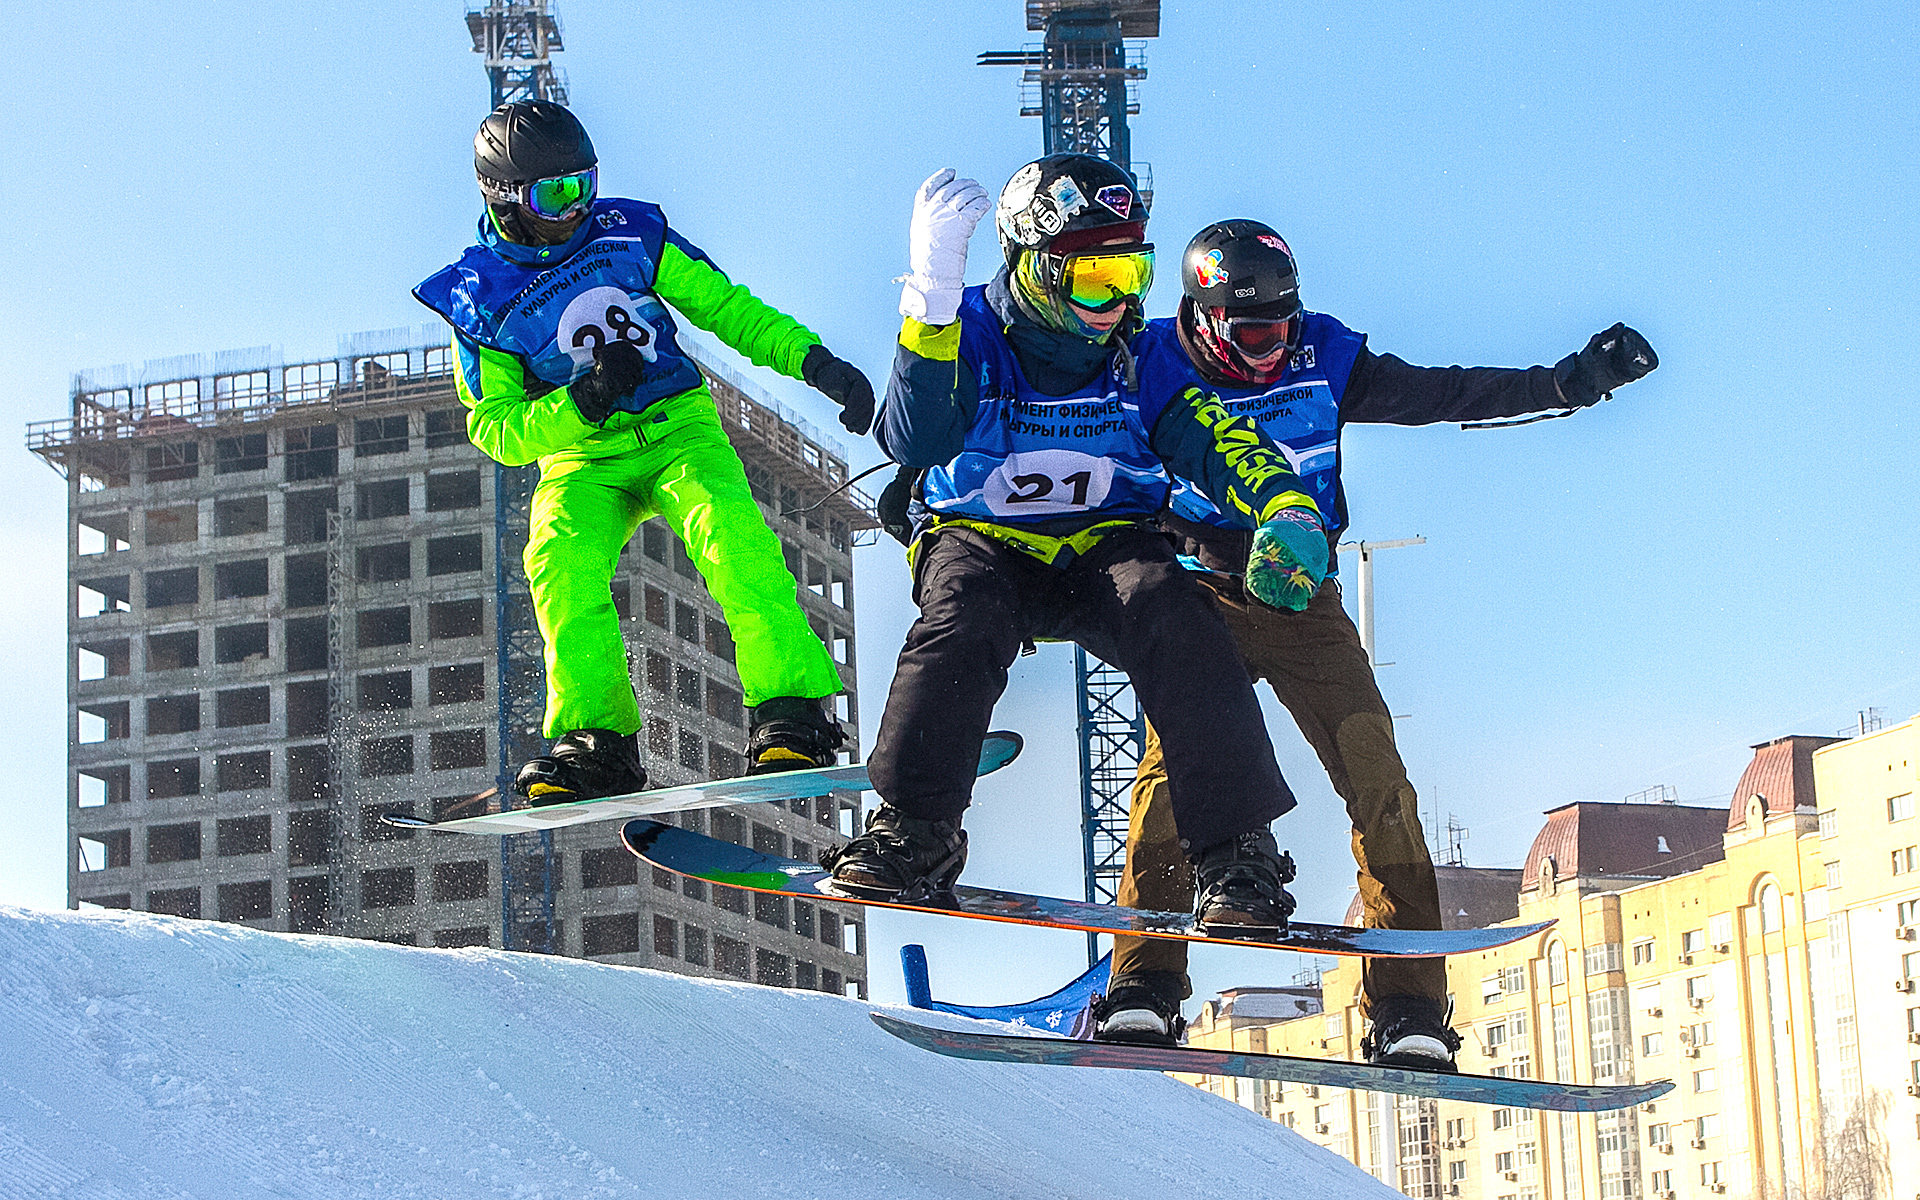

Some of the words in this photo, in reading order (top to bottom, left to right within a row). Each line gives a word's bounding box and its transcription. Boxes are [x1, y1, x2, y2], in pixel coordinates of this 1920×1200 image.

[494, 267, 561, 323] ДЕПАРТАМЕНТ
[562, 241, 630, 270] ФИЗИЧЕСКОЙ
[520, 277, 571, 318] КУЛЬТУРЫ
[571, 270, 582, 284] И
[571, 304, 650, 361] 28
[1237, 386, 1313, 412] ФИЗИЧЕСКОЙ
[1059, 424, 1070, 438] И
[1073, 419, 1129, 438] СПОРТА
[1005, 471, 1092, 505] 21
